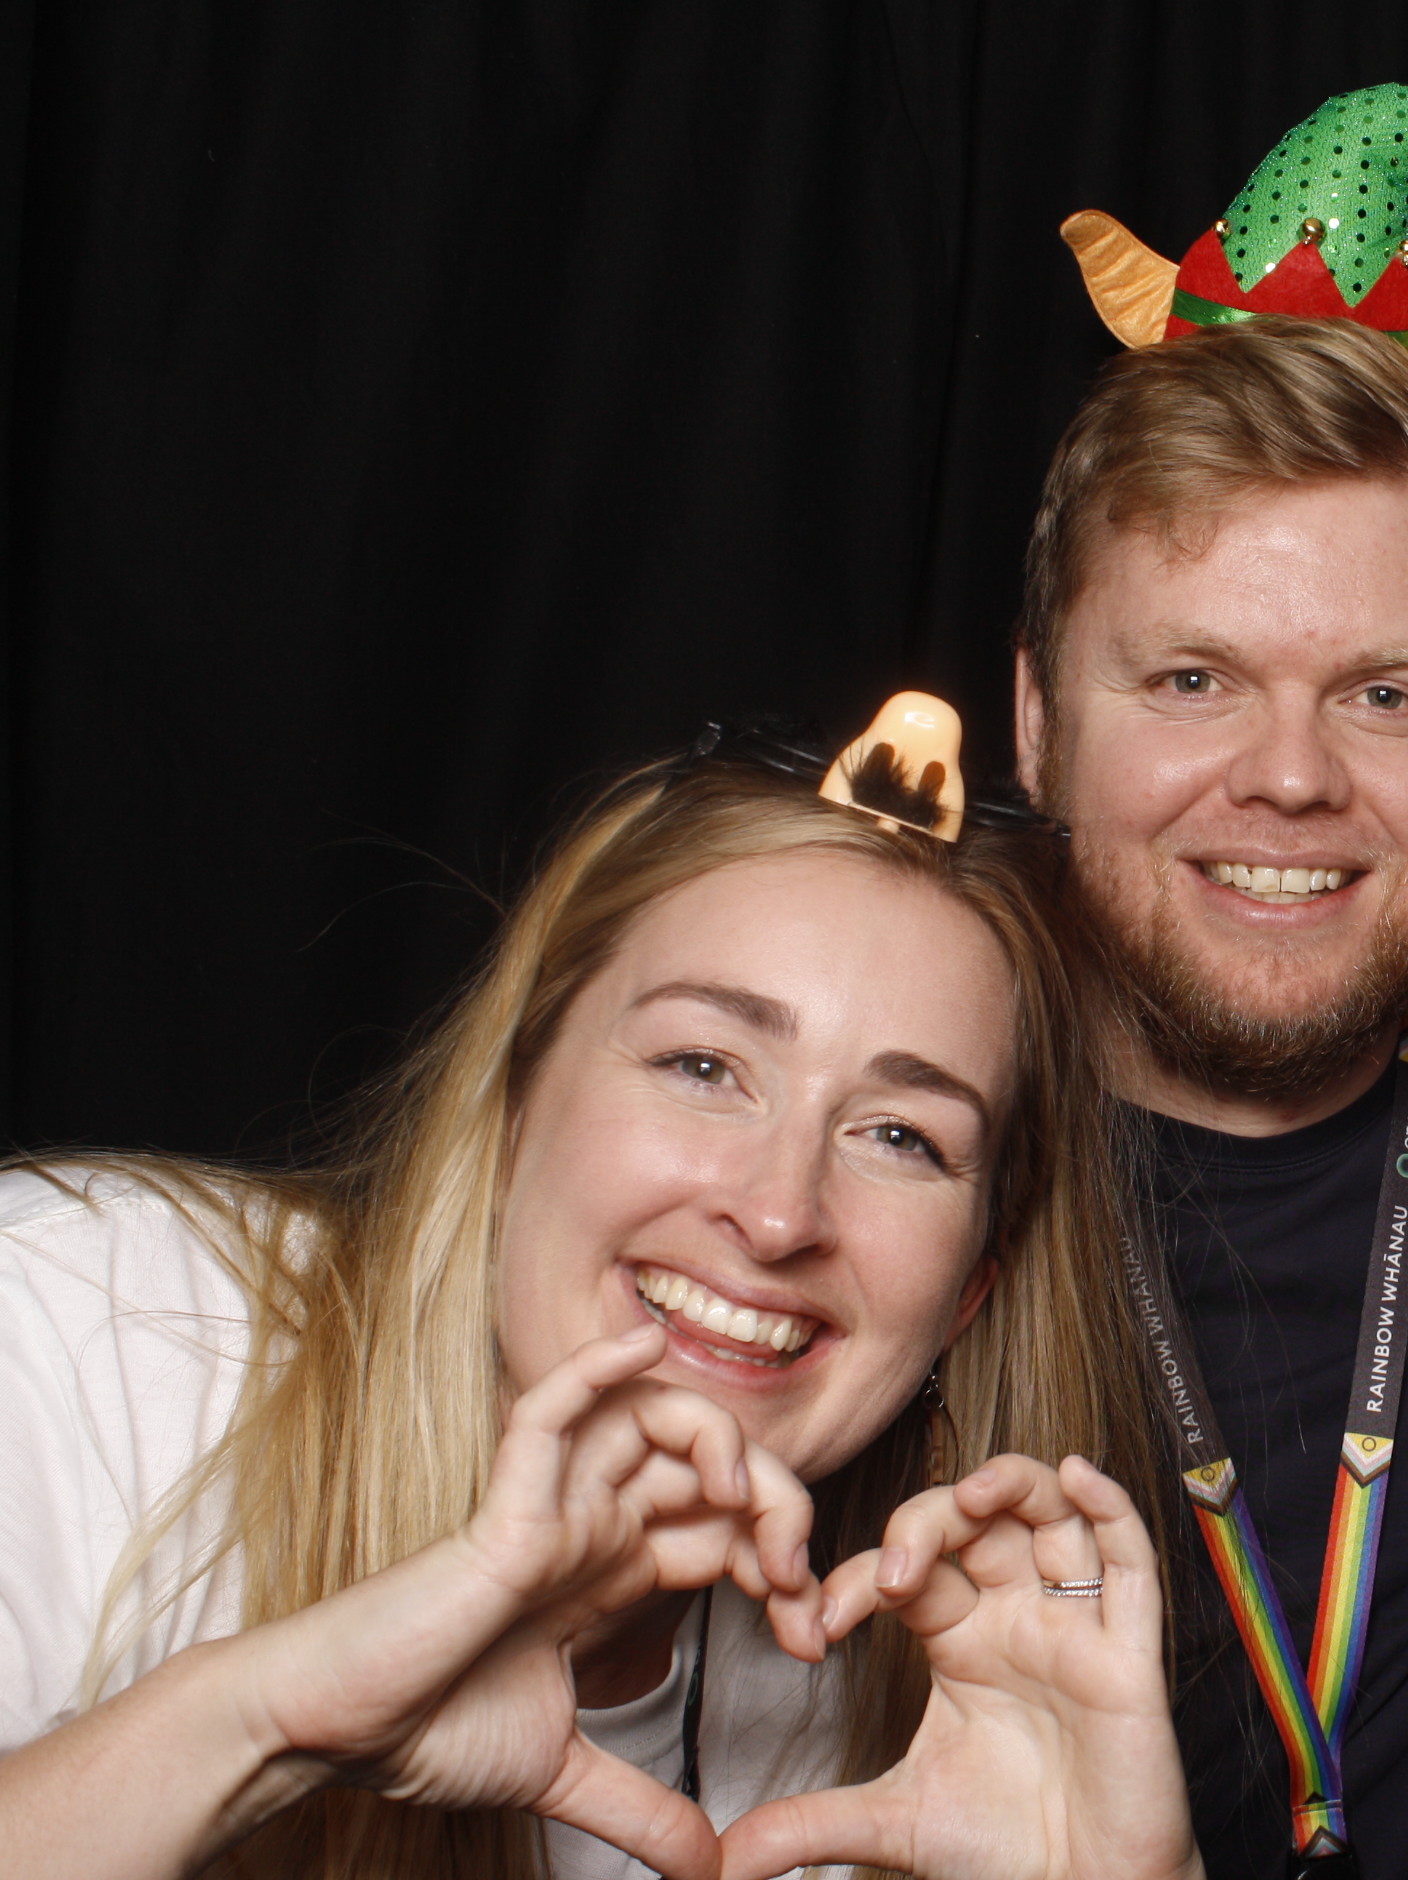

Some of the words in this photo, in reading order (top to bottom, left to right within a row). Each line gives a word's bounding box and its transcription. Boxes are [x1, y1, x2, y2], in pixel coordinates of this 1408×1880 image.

[1366, 1307, 1395, 1413] RAINBOW
[1381, 1205, 1408, 1302] WHĀNAU
[1153, 1340, 1204, 1444] RAINBOW
